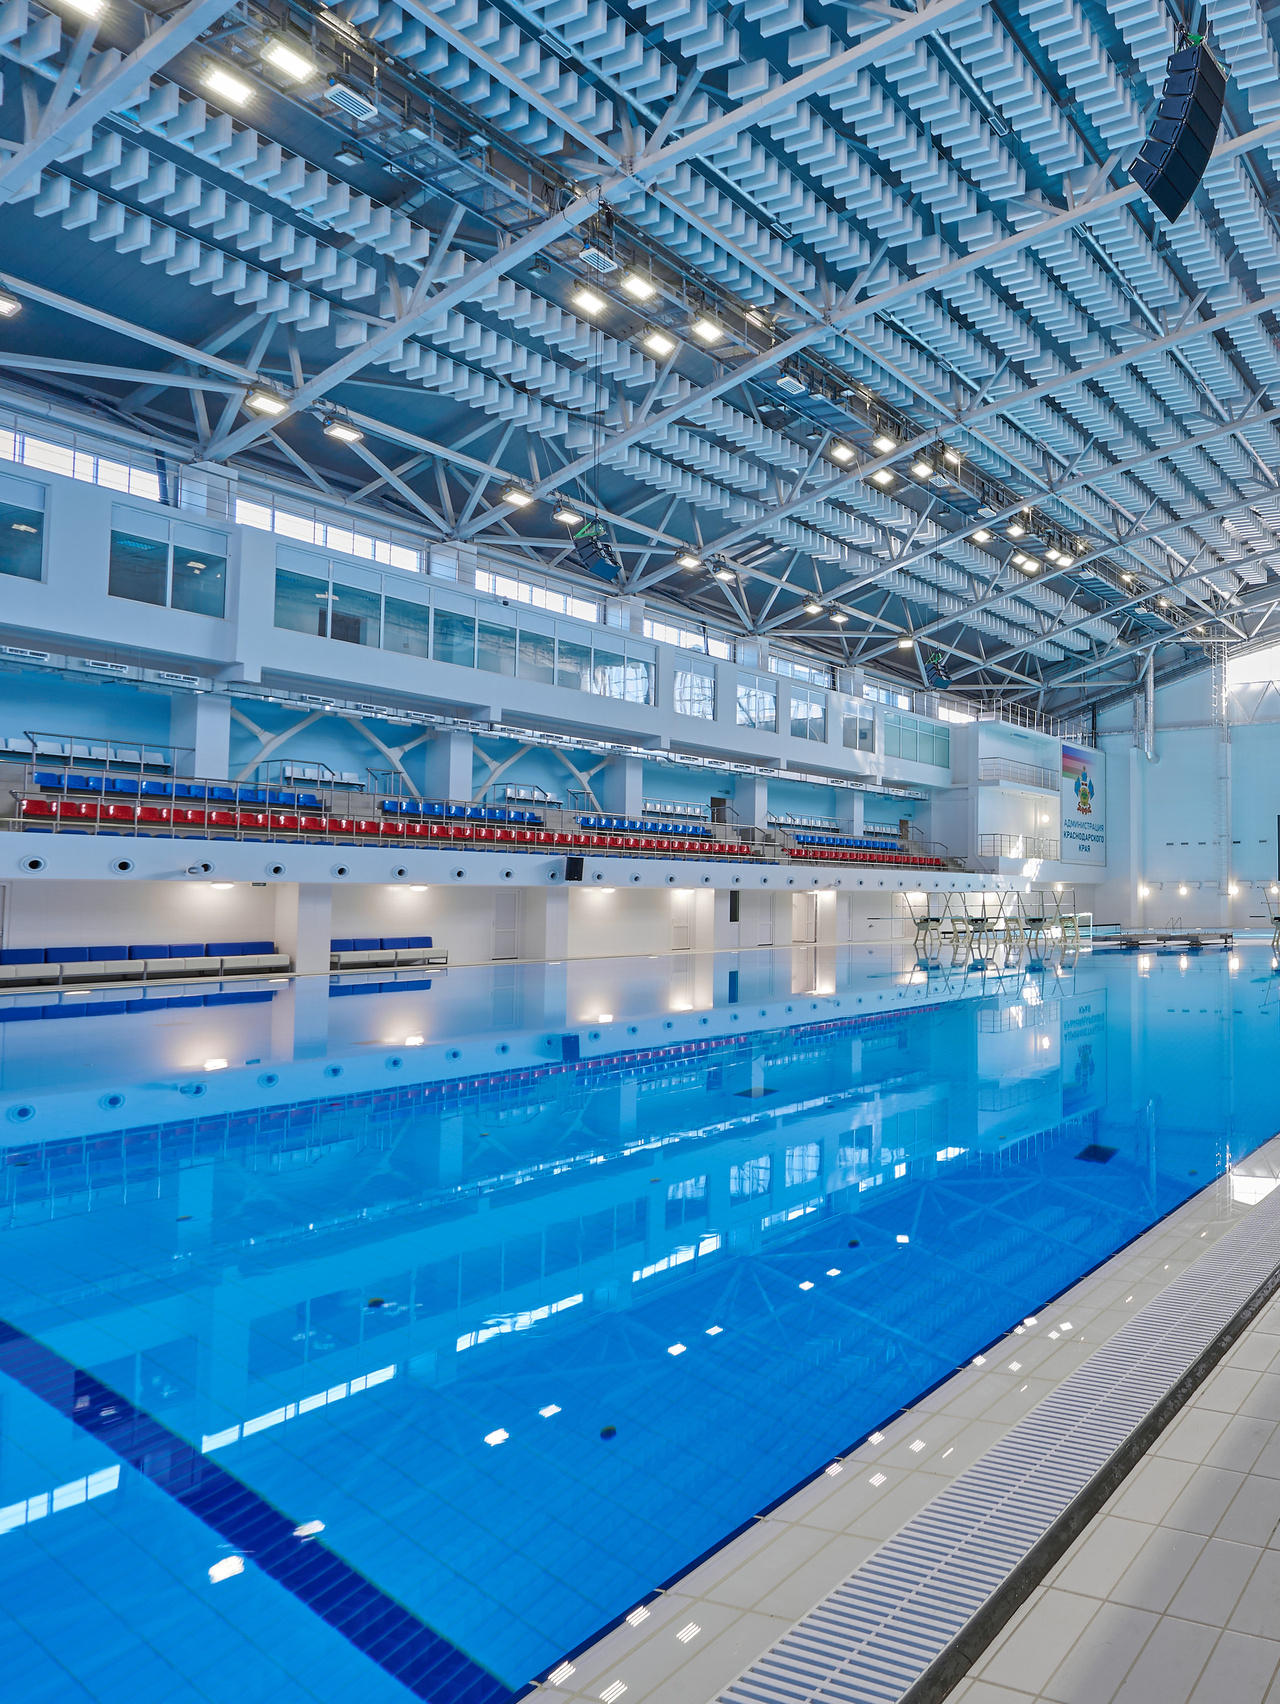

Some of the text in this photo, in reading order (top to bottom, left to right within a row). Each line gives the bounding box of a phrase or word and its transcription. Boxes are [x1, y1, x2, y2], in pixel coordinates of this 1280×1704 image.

[1063, 819, 1104, 832] АДМИНИСТРАЦИЯ
[1063, 830, 1104, 843] КРАСНОДАРСКОГО
[1078, 844, 1091, 853] КРАЯ
